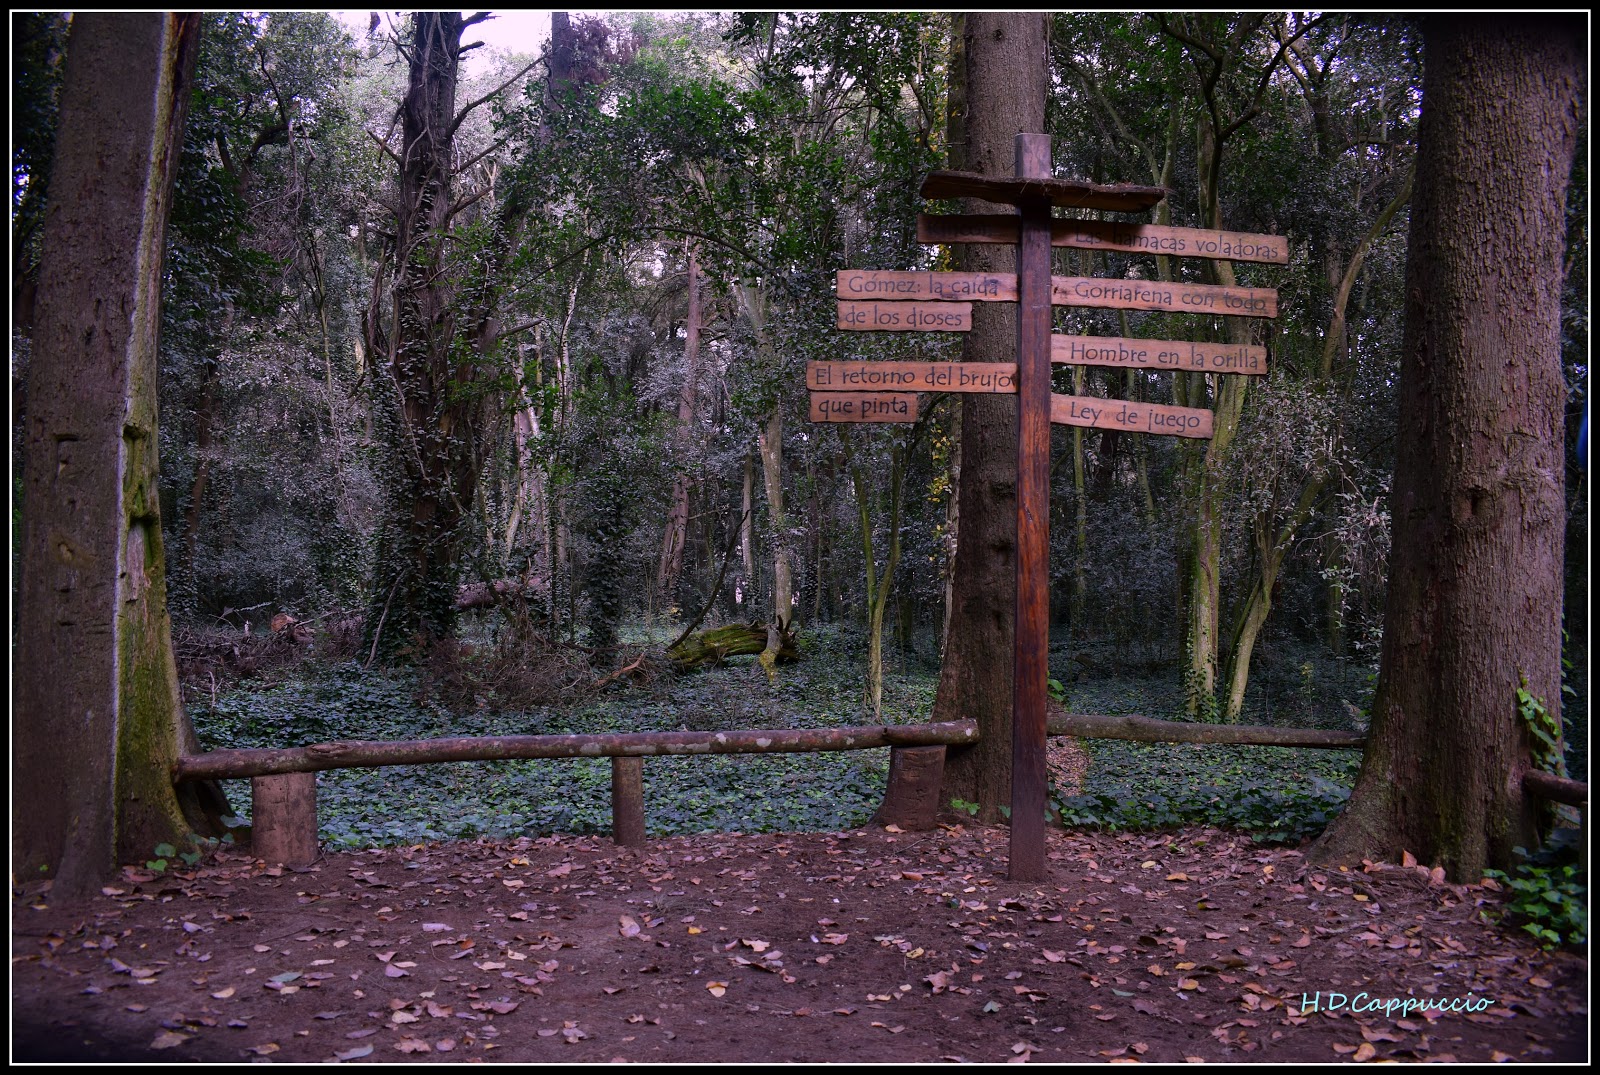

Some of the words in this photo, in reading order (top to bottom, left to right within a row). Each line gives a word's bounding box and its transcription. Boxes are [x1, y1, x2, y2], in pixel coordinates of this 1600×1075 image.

[1075, 222, 1102, 245] Las
[1111, 222, 1185, 252] hamacas
[1196, 234, 1279, 258] voladoras
[848, 272, 921, 294] Gómez:
[929, 273, 943, 294] la
[951, 275, 998, 296] caída
[1074, 281, 1172, 306] Gorriarena
[1181, 292, 1214, 307] con
[1222, 290, 1266, 312] todo
[845, 305, 866, 326] de
[874, 305, 900, 325] los
[906, 307, 962, 327] dioses
[1070, 342, 1147, 363] Hombre
[1158, 351, 1179, 365] en
[1190, 345, 1204, 367] la
[1212, 348, 1258, 370] orilla
[816, 365, 832, 385] El
[842, 367, 915, 384] retorno
[924, 366, 951, 386] del
[960, 367, 1012, 392] brujo
[818, 400, 853, 420] que
[861, 396, 908, 418] pinta
[1070, 401, 1102, 425] Ley
[1116, 405, 1138, 425] de
[1148, 409, 1201, 433] juego
